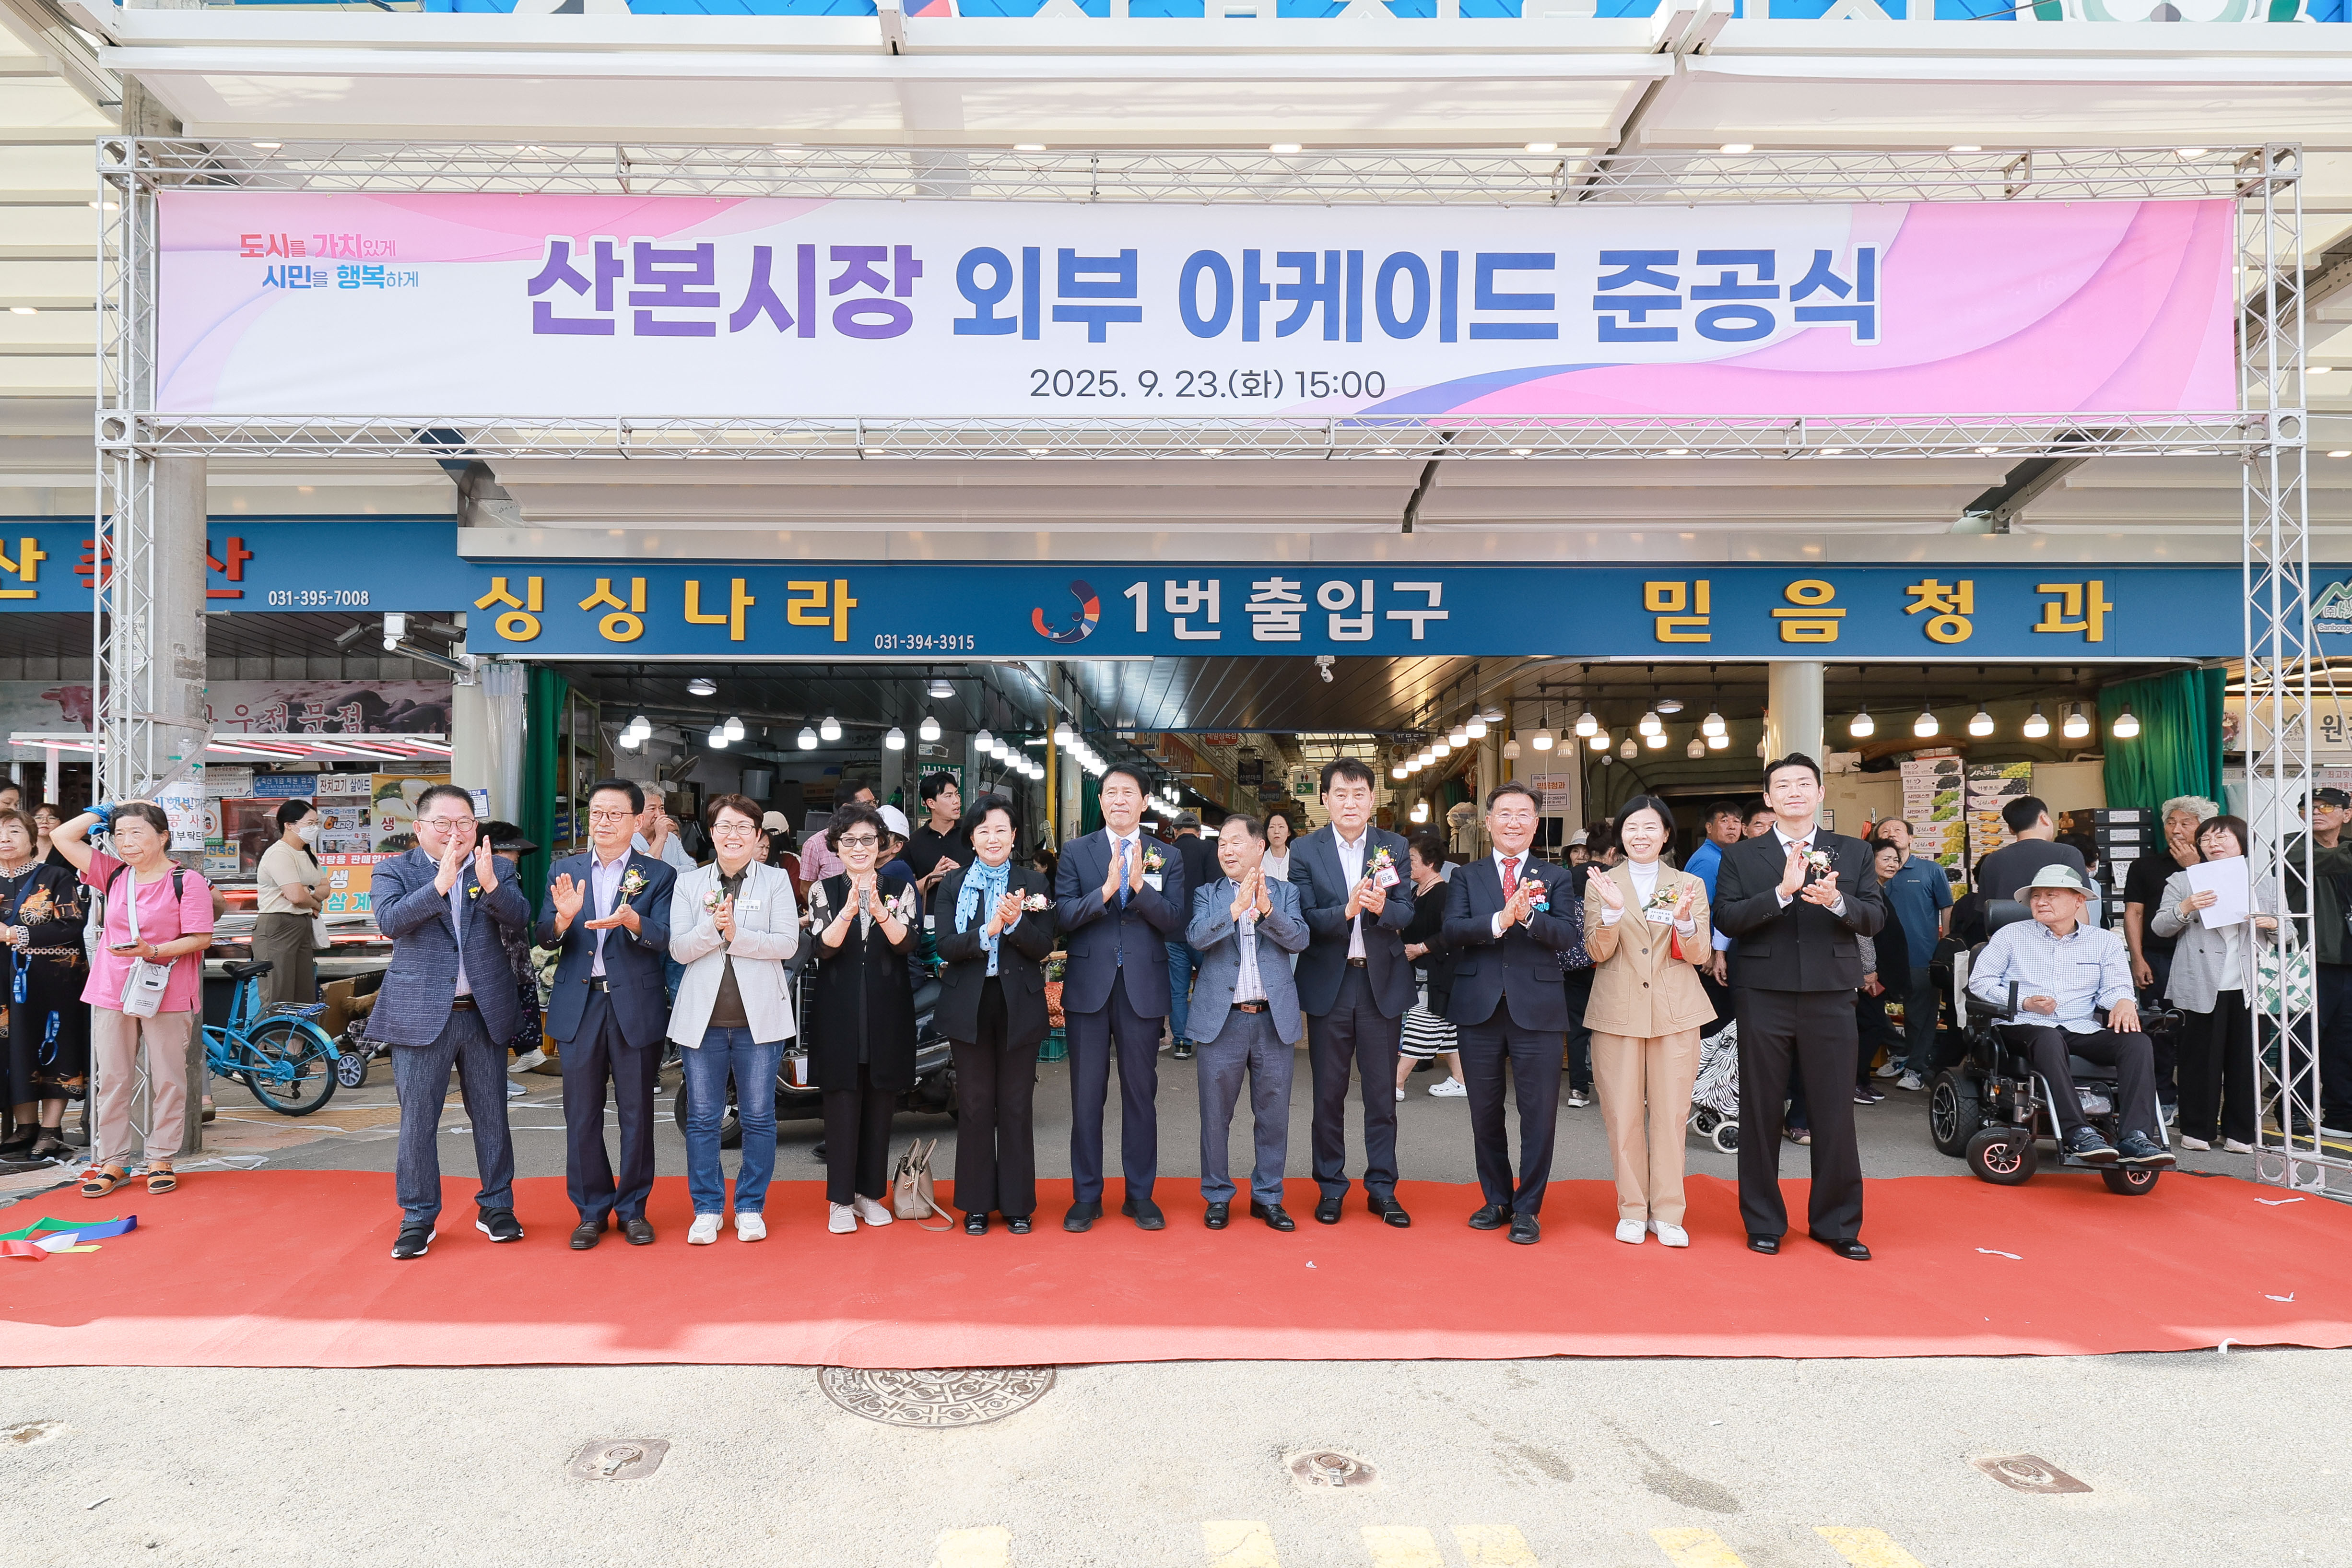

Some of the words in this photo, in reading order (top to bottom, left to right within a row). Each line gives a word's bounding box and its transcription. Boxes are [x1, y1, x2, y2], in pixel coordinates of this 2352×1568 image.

[240, 233, 306, 259] 도시를
[313, 233, 396, 259] 가치있게
[262, 265, 329, 289] 시민을
[336, 264, 419, 289] 행복하게
[527, 240, 923, 340] 산본시장
[953, 246, 1142, 343] 외부
[1178, 248, 1559, 343] 아케이드
[1592, 247, 1876, 342] 준공식
[1030, 369, 1126, 398] 2025.
[1138, 369, 1164, 398] 9.
[1175, 369, 1283, 400] 23.(화)
[1295, 370, 1386, 399] 15:00
[268, 590, 370, 606] 031-395-7008
[1123, 578, 1221, 641] 1번
[1245, 577, 1449, 641] 출입구
[874, 634, 975, 650] 031-394-3915
[320, 779, 347, 793] 잔치고기
